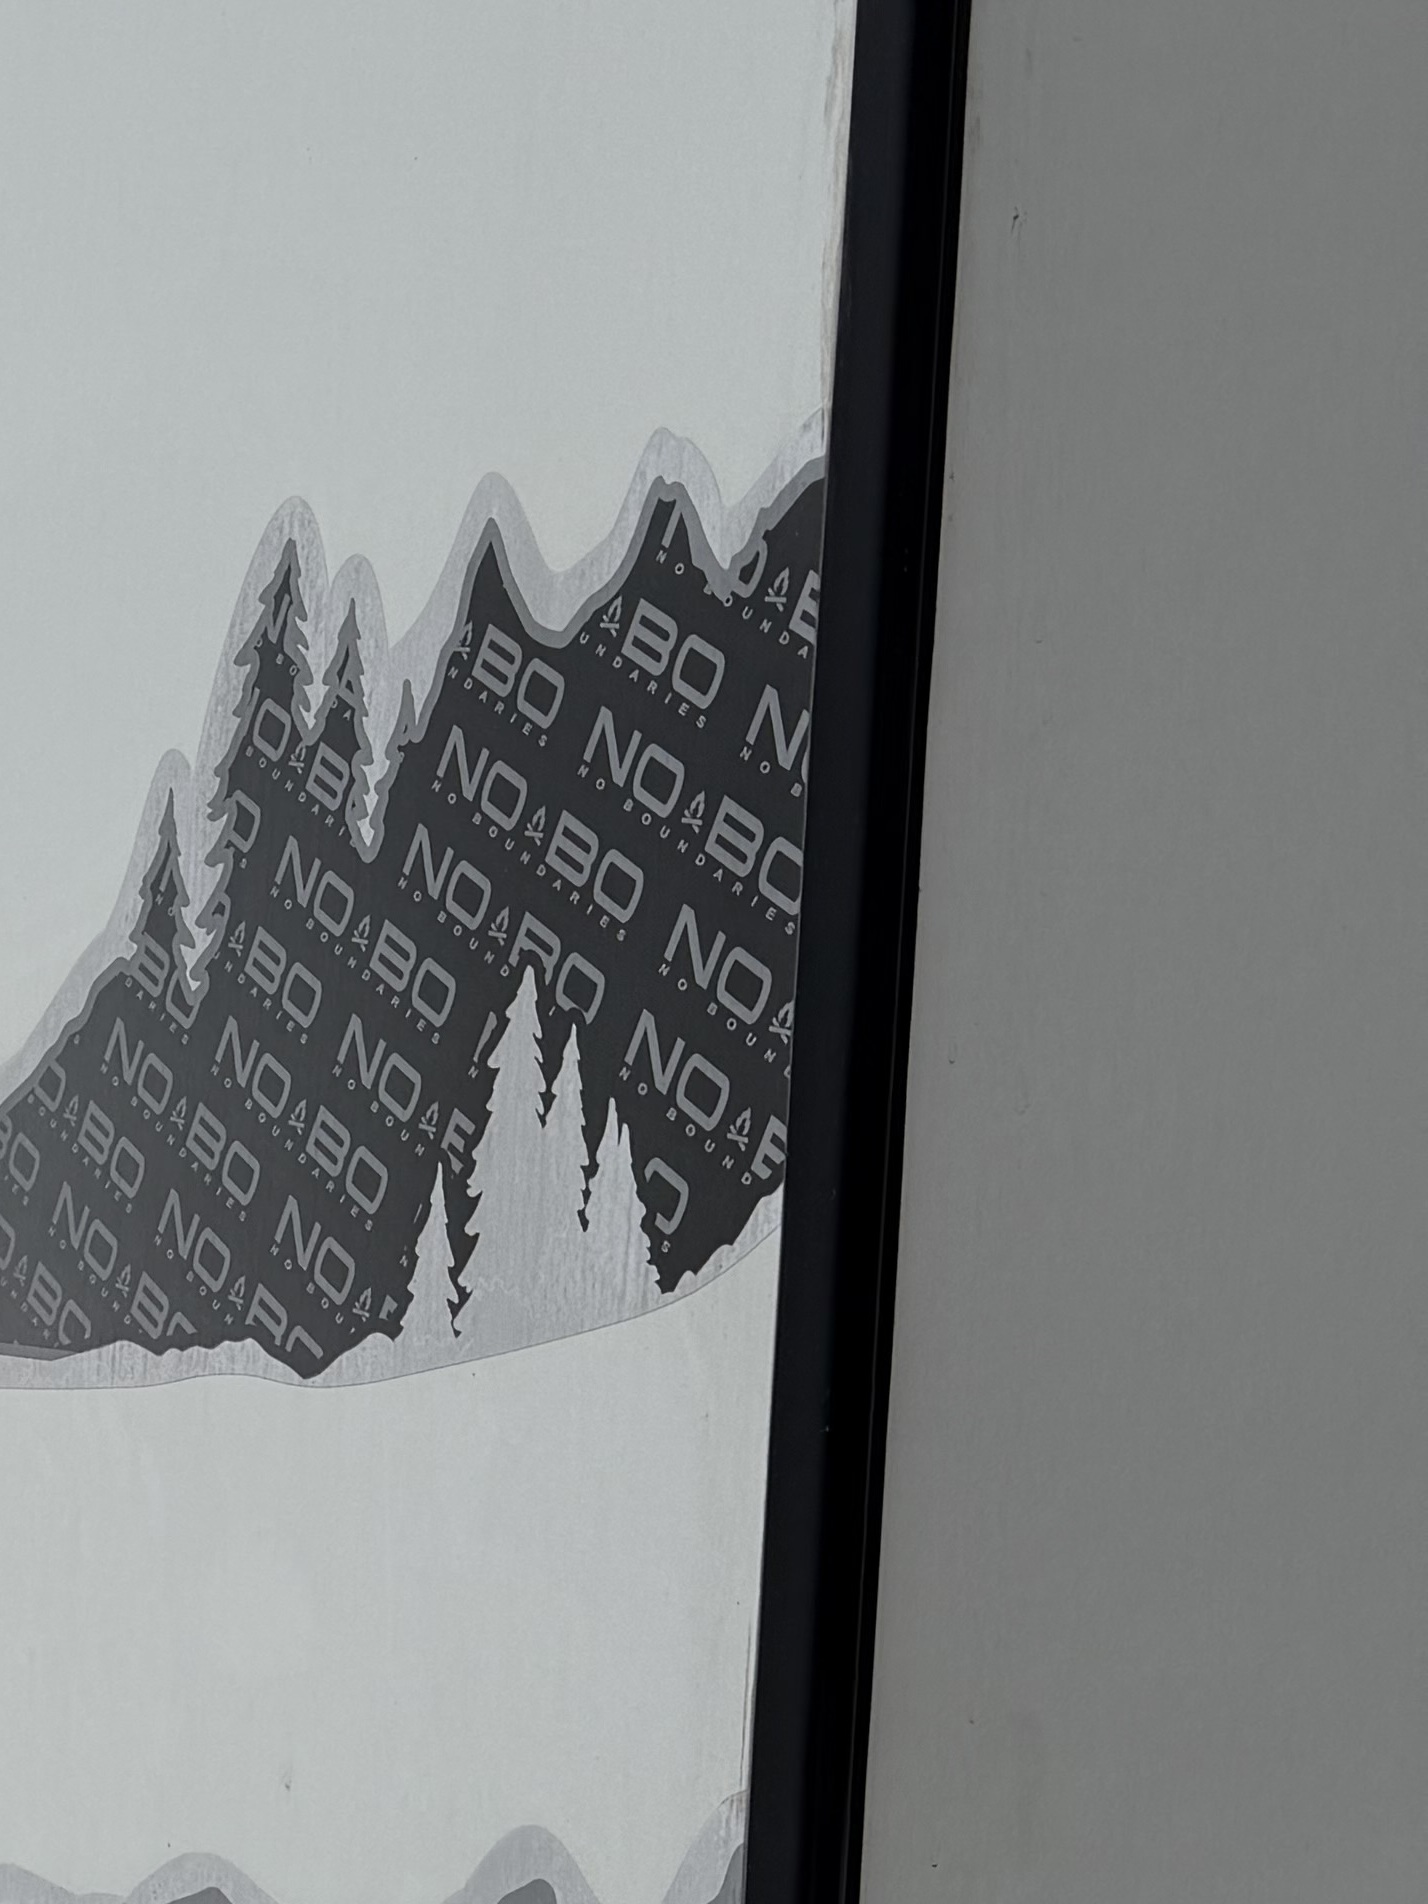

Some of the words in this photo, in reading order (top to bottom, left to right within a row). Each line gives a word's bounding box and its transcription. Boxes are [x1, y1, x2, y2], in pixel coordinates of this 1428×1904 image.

[471, 623, 565, 729] BO
[621, 598, 726, 710] BO
[583, 706, 686, 819] NO
[402, 823, 492, 931] NO
[436, 724, 528, 832] NO
[545, 809, 644, 924] BO
[472, 812, 627, 942] BOUNDARIES
[577, 764, 606, 791] NO
[623, 799, 796, 936] BOUNDARIES
[244, 926, 323, 1029] BO
[274, 835, 355, 937] NO
[369, 919, 457, 1028] BO
[306, 919, 441, 1045] BOUNDARIES
[658, 963, 688, 991] NO
[663, 904, 773, 1025] NO
[104, 1016, 174, 1116] NO
[185, 1101, 261, 1207] BO
[215, 1015, 292, 1119] NO
[306, 1104, 388, 1216] BO
[337, 1013, 422, 1123] NO
[619, 1067, 649, 1096] NO
[624, 1009, 730, 1132] NO
[77, 1099, 145, 1200] BO
[244, 1098, 374, 1232] BOUNDARIES
[51, 1181, 119, 1282] NO
[157, 1187, 232, 1293] NO
[274, 1194, 356, 1307] NO
